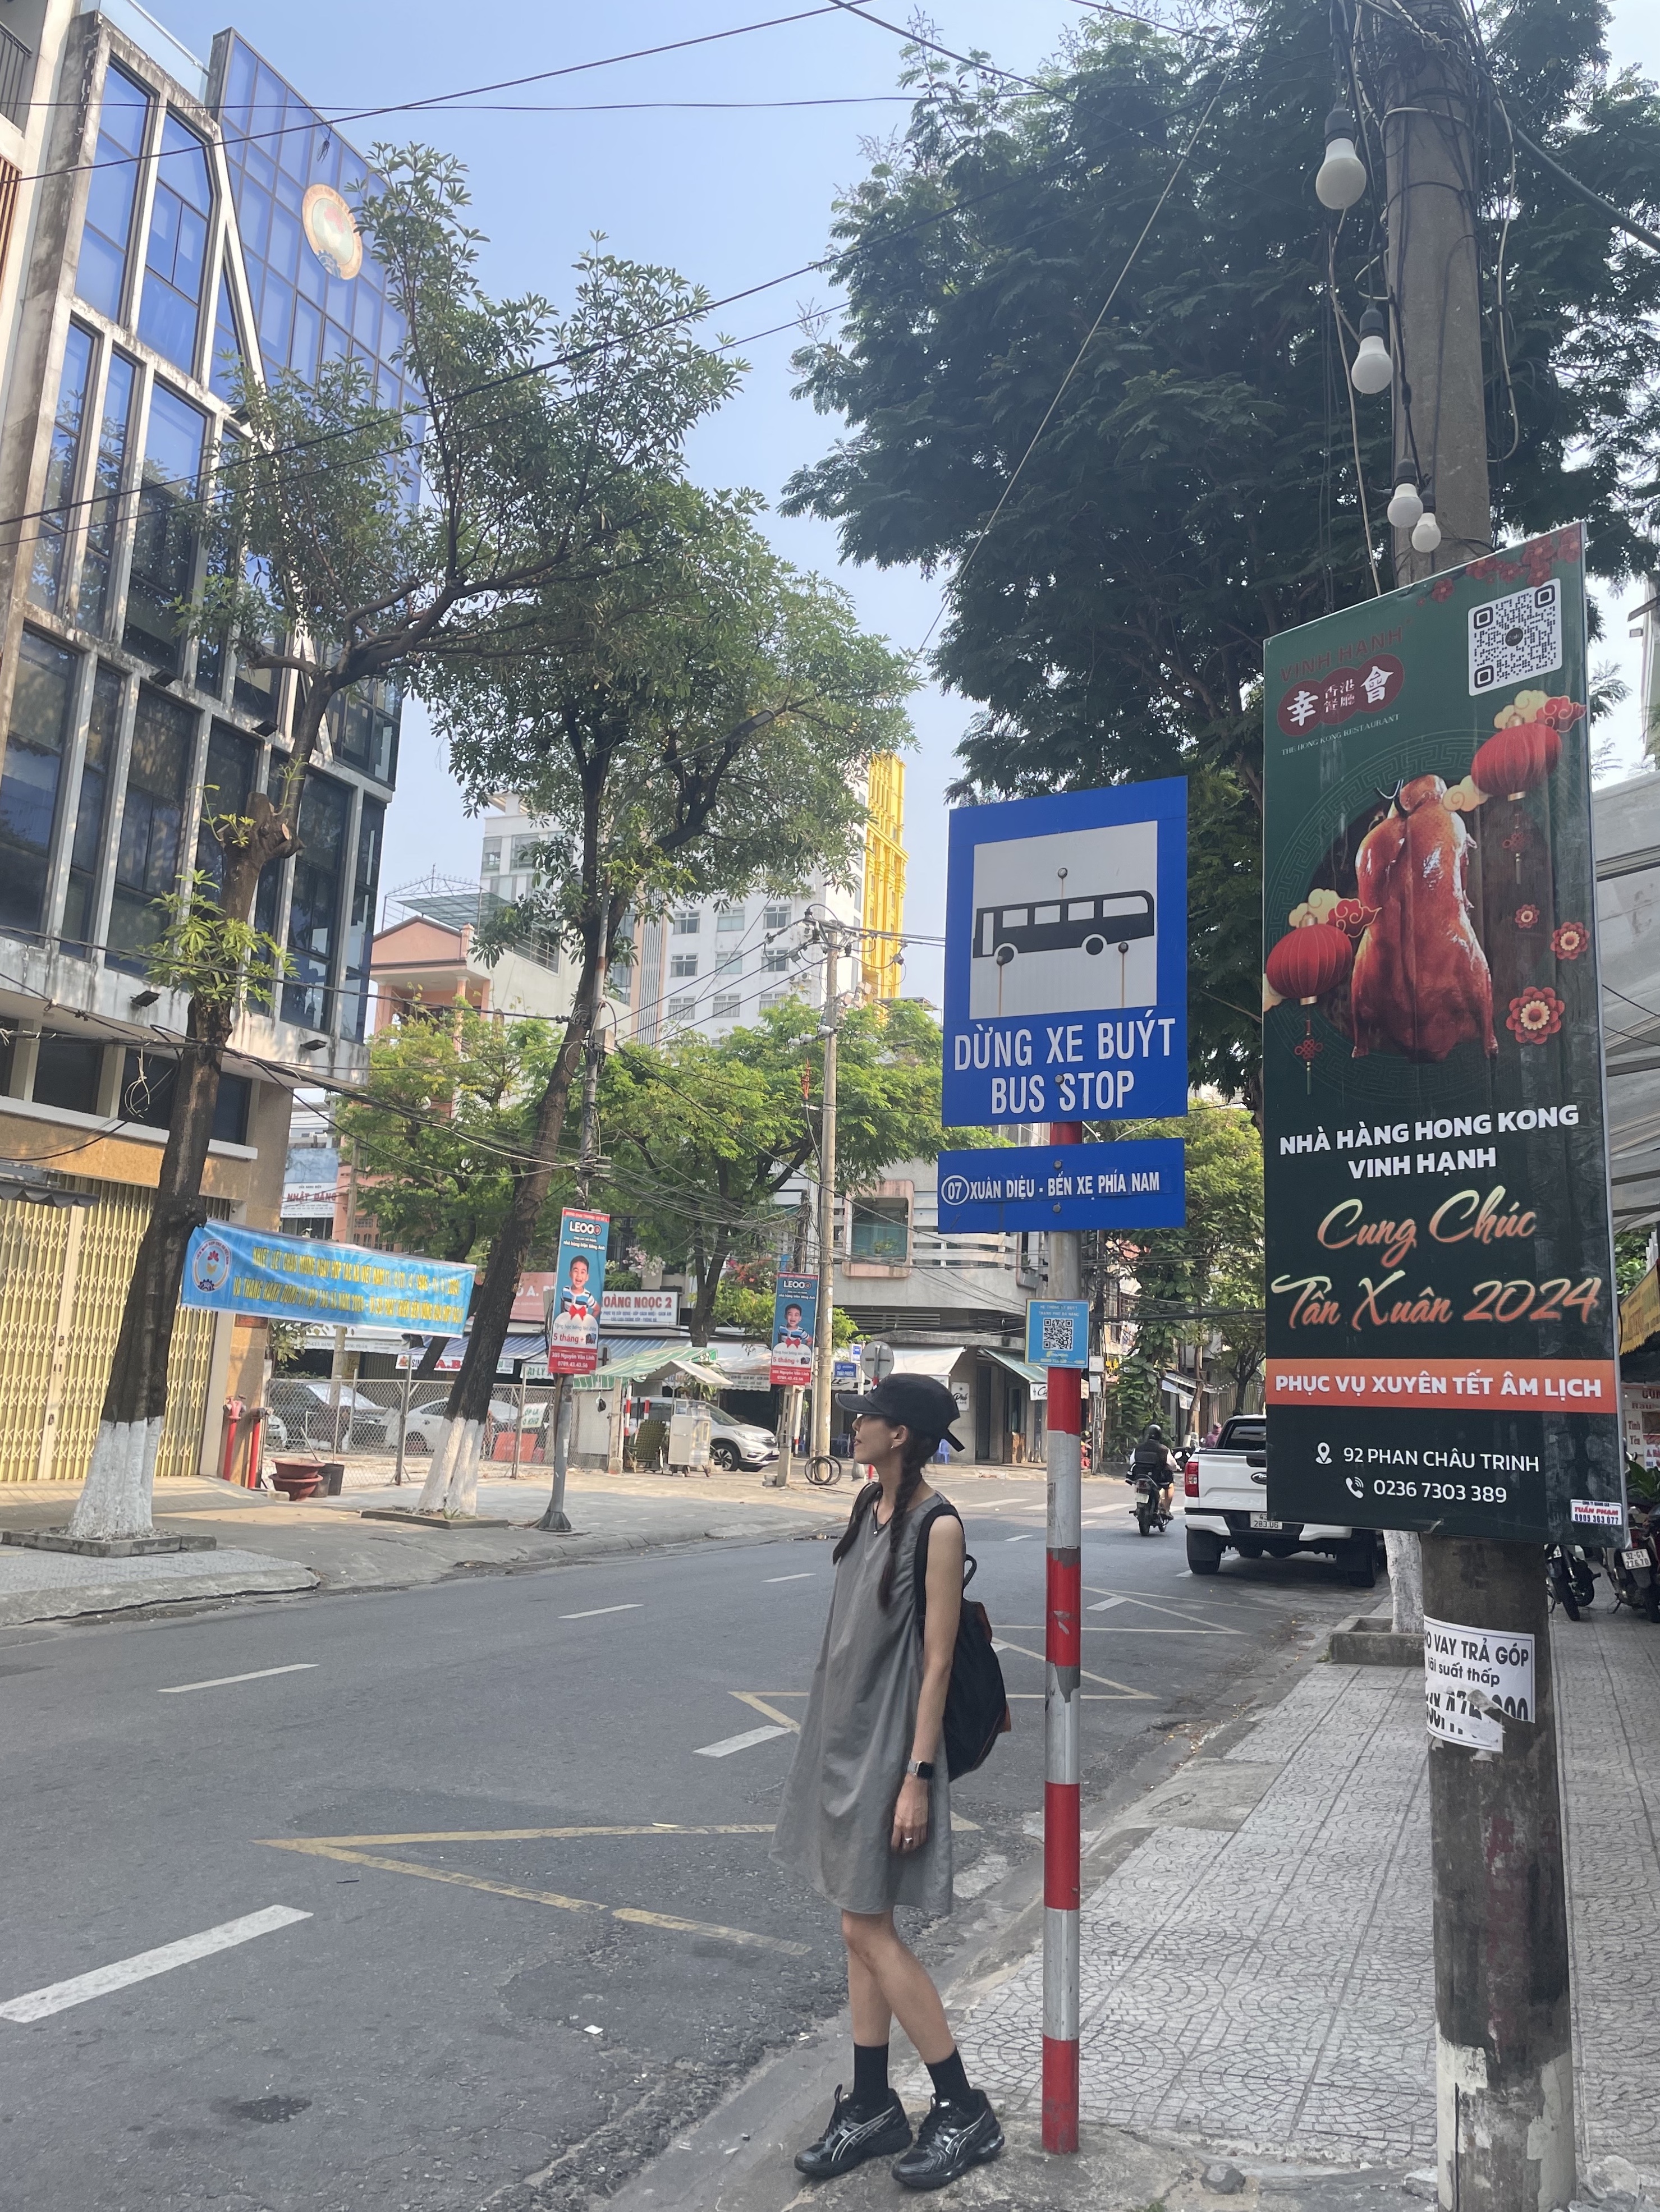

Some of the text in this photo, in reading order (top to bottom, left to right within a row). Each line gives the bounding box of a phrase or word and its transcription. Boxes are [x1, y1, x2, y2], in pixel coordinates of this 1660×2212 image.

[1280, 625, 1402, 682] VINH HẠNH
[1286, 690, 1319, 727] 幸
[1281, 713, 1401, 756] THE HONG KONG RESTAURANT
[954, 1009, 1176, 1071] DỪNG XE BUÝT
[991, 1070, 1135, 1114] BUS STOP
[1279, 1104, 1580, 1156] NHÀ HÀNG HONG KONG
[1348, 1147, 1497, 1180] VINH HẠNH
[947, 1181, 962, 1200] 07
[969, 1176, 1002, 1200] XUÂN
[1006, 1175, 1035, 1200] DIỆU
[1048, 1171, 1072, 1197] BẾN
[1076, 1175, 1093, 1195] XE
[1098, 1169, 1127, 1194] PHÍA
[1131, 1171, 1160, 1192] NAM
[1317, 1185, 1538, 1268] Cung Chúc
[601, 1293, 672, 1311] OÀNG NGỌC 2
[1271, 1274, 1342, 1330] Tân
[1351, 1269, 1455, 1332] Xuân
[1462, 1276, 1603, 1324] 2024
[560, 1333, 579, 1344] tháng
[1275, 1368, 1602, 1403] PHỤC VỤ XUYÊN TẾT ÂM LỊCH
[1343, 1447, 1540, 1473] 92 PHAN CHÂU TRINH
[1211, 1496, 1262, 1506] RAN
[1373, 1479, 1507, 1503] 0236 7303 389
[1574, 1505, 1594, 1514] TUẤN
[1607, 1516, 1619, 1525] 077
[1625, 1550, 1645, 1560] 92-G1
[1434, 1633, 1457, 1656] VAY
[1461, 1637, 1491, 1663] TRẢ
[1496, 1642, 1529, 1667] GÓP
[1428, 1656, 1500, 1688] lãi suất thấp
